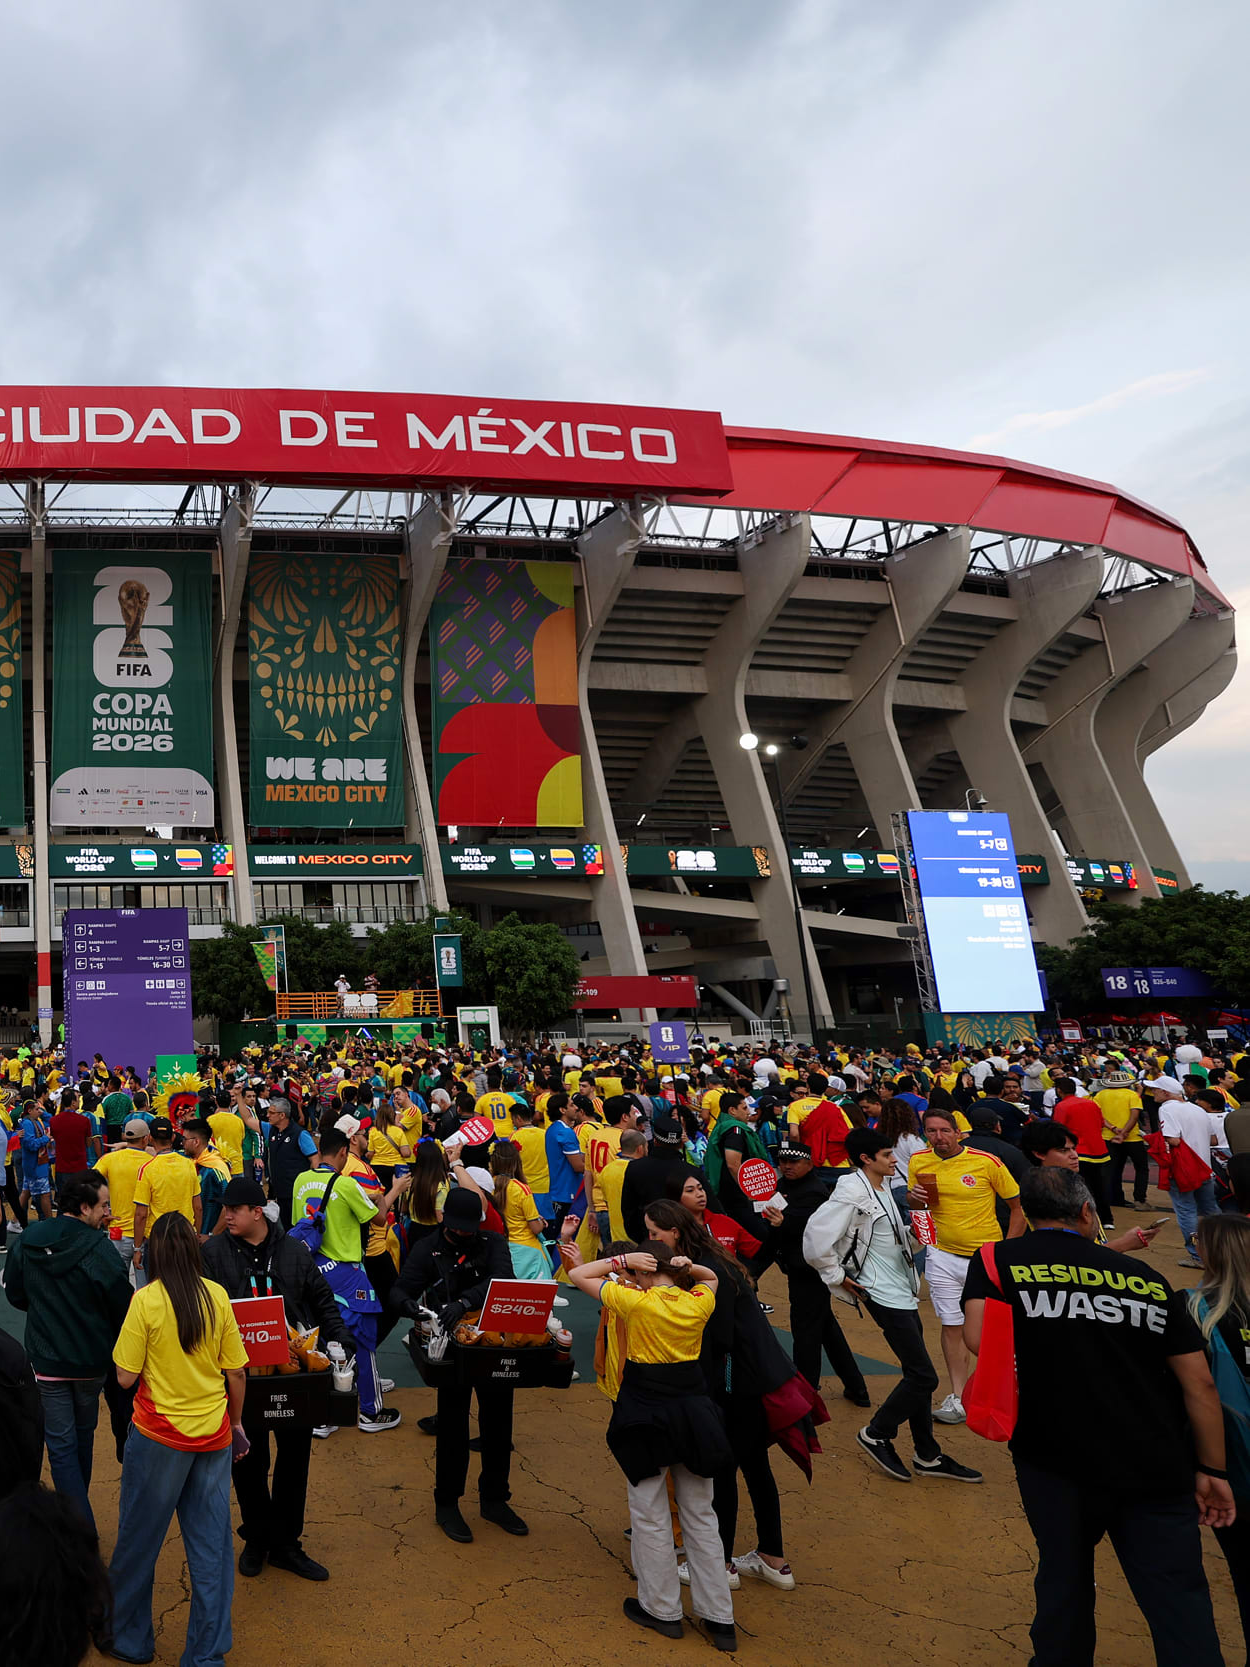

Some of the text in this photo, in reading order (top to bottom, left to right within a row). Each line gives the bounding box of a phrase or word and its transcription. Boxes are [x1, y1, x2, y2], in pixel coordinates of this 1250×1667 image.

[280, 411, 377, 448] DE
[406, 408, 678, 464] MÉXICO
[116, 664, 152, 677] FIFA
[92, 693, 174, 716] COPA
[92, 717, 174, 732] MUNDIAL
[92, 734, 174, 751] 2026
[266, 757, 316, 781] WE
[265, 784, 387, 803] MEXICO CITY
[80, 848, 99, 856] FIFA
[65, 856, 114, 864] WORLD CUP
[254, 854, 413, 866] WELCOME TO MEXICO CITY
[1106, 976, 1128, 990] 18
[1134, 979, 1150, 994] 18
[490, 1103, 506, 1120] 10
[590, 1139, 610, 1174] 10
[742, 1167, 770, 1179] CASHLESS
[744, 1162, 766, 1172] EVENTO
[745, 1182, 768, 1192] TARJETA
[1009, 1263, 1168, 1301] RESIDUOS
[490, 1303, 536, 1316] $240
[1018, 1289, 1168, 1335] WASTE
[270, 1394, 288, 1402] FRIES
[264, 1409, 295, 1418] BONELESS
